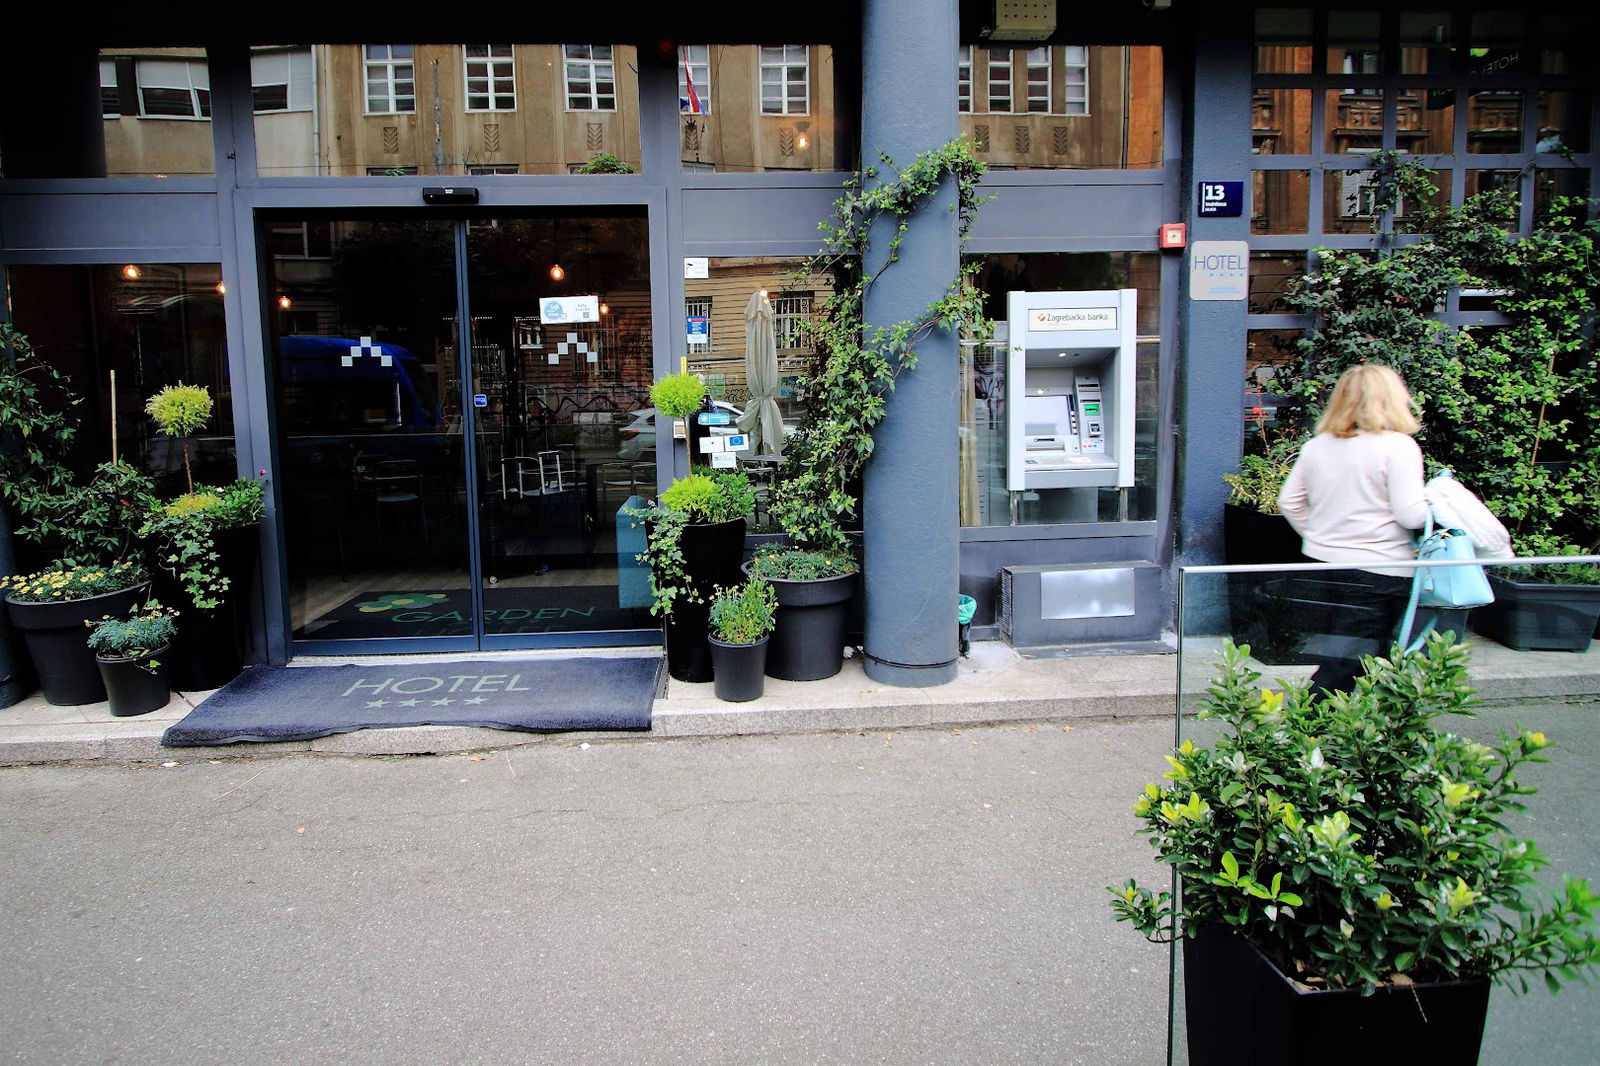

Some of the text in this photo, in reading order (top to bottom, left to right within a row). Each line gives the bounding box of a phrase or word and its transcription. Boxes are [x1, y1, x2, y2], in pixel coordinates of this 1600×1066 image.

[1205, 185, 1225, 201] 13
[1194, 254, 1247, 270] HOTEL
[1087, 313, 1108, 321] banka
[391, 606, 595, 623] GARDEN
[341, 673, 530, 697] HOTEL
